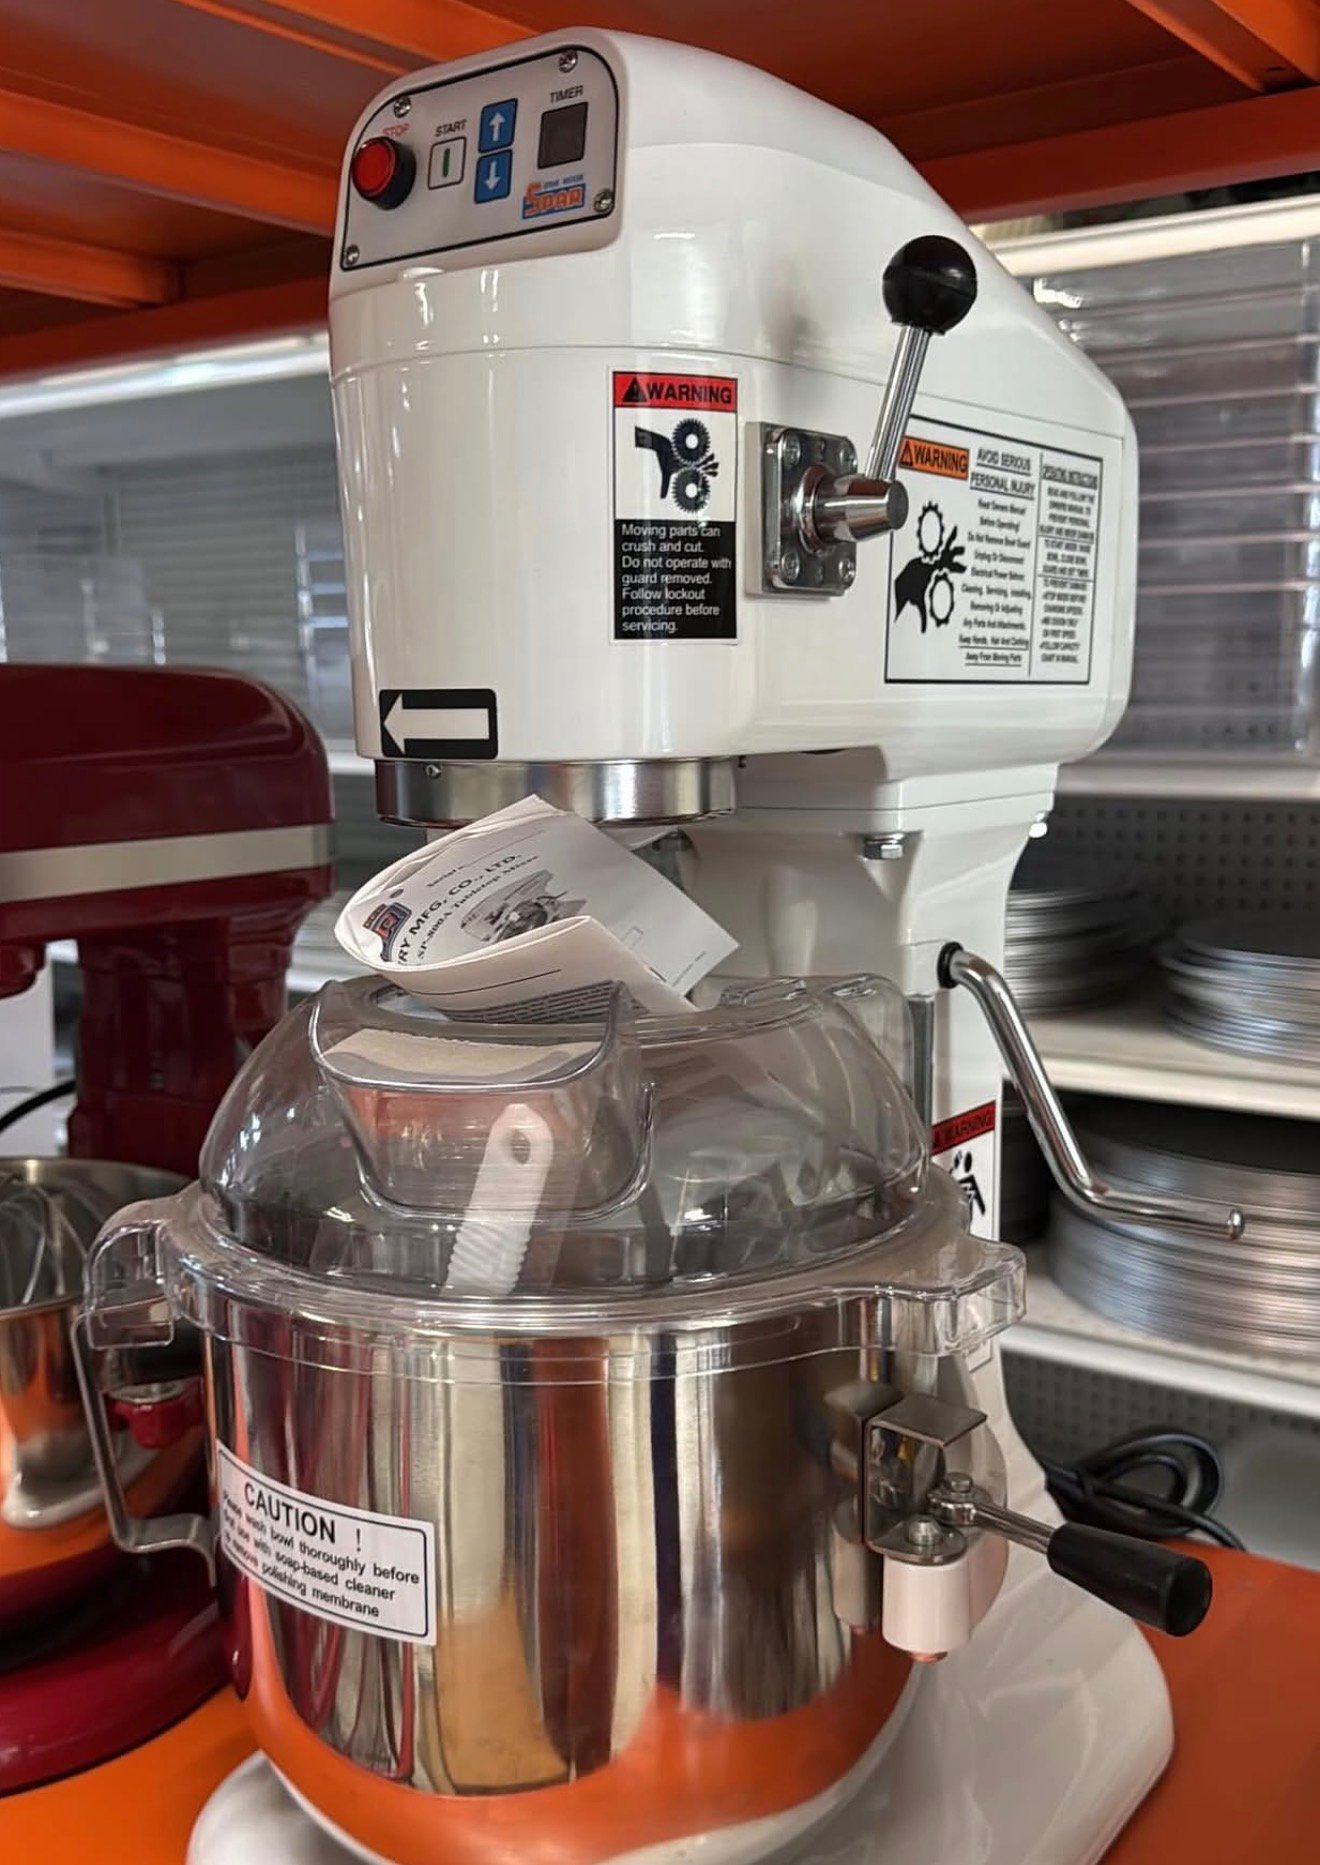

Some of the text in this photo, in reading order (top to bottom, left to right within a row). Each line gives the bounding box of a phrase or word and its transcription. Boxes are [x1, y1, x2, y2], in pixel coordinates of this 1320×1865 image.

[549, 85, 584, 103] TIMER
[383, 122, 410, 137] STOP
[435, 119, 467, 137] START
[646, 382, 732, 405] WARNING
[913, 444, 967, 473] WARNING
[977, 447, 1031, 471] AVOID SERIOUS
[970, 471, 1008, 492] PERSONAL
[1010, 479, 1036, 496] INJURY
[621, 523, 721, 539] Moving parts can
[621, 540, 704, 553] crush and cut.
[622, 555, 732, 571] Do not operate with
[621, 572, 712, 587] guard removed.
[622, 586, 705, 600] Follow lockout
[621, 603, 720, 618] procedure before
[621, 620, 678, 634] servicing.
[244, 1482, 362, 1552] CAUTION !
[271, 1526, 295, 1550] bowl
[300, 1540, 366, 1577] thoroughly
[373, 1562, 420, 1584] before
[276, 1550, 339, 1586] soap-based
[345, 1577, 396, 1601] cleaner
[262, 1561, 307, 1597] polishing
[312, 1587, 380, 1618] membrane
